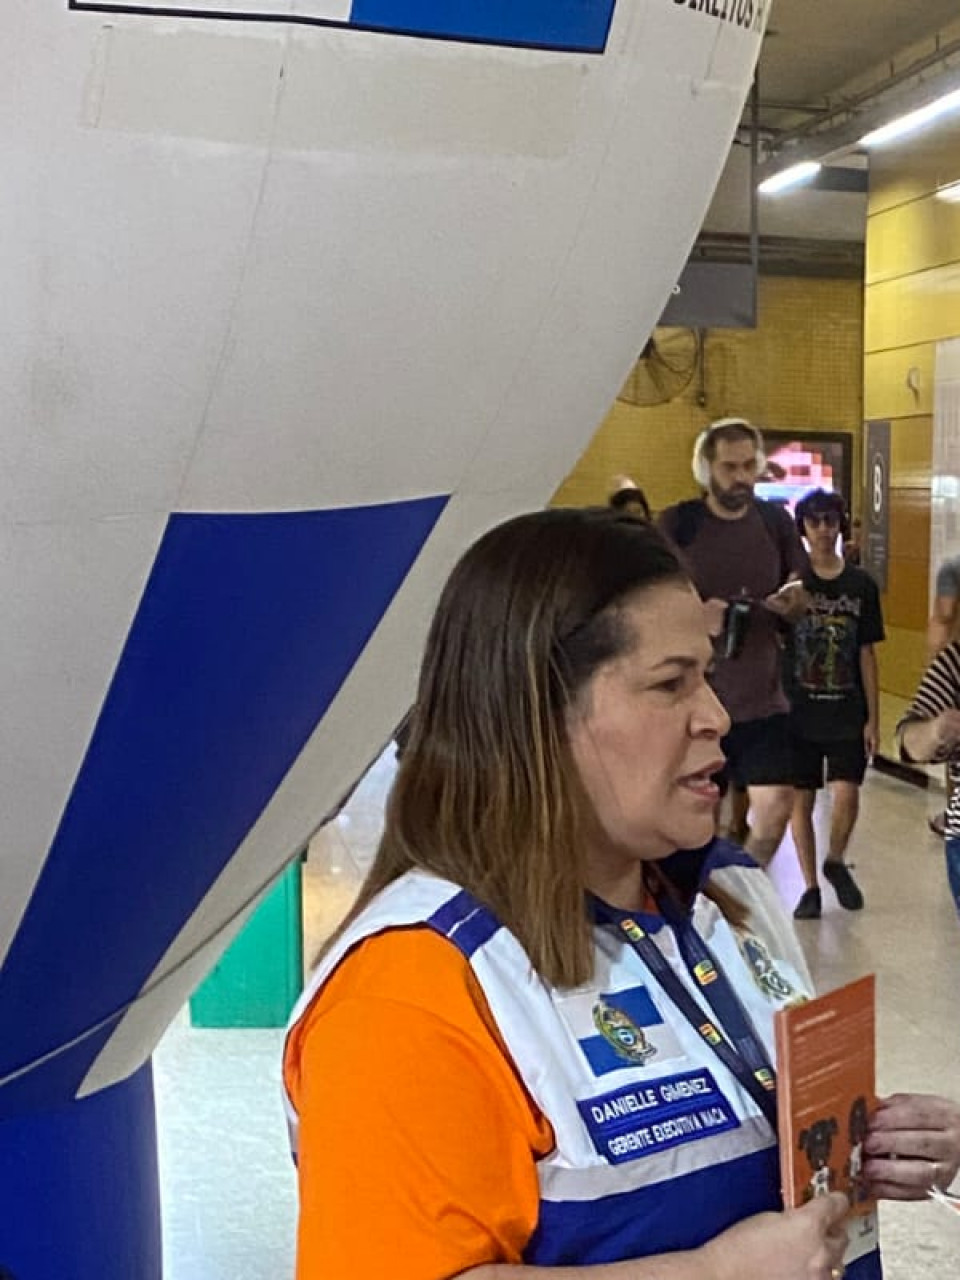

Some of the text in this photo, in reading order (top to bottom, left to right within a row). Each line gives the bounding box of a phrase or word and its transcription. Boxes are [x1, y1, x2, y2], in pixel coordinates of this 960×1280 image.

[591, 1077, 712, 1123] DANIELLE GIMENEZ
[607, 1127, 654, 1155] GERENTE
[652, 1113, 702, 1142] EXECUTIVA
